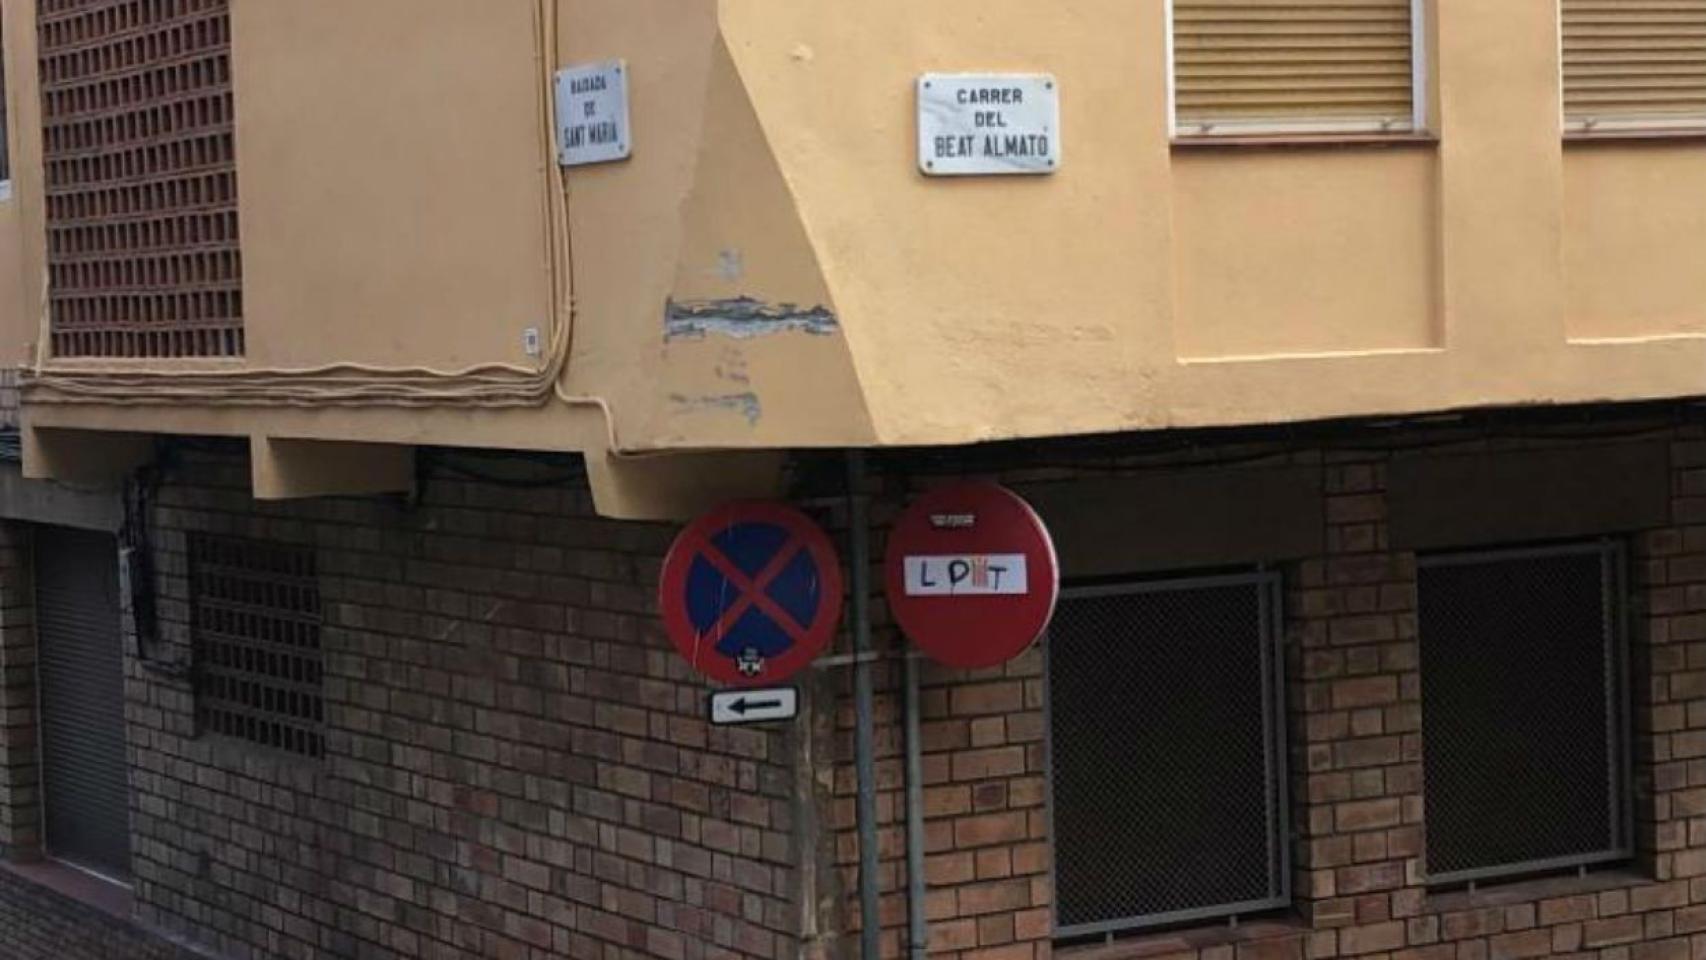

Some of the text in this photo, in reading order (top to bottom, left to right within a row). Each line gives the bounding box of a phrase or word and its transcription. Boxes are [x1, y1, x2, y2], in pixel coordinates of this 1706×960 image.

[956, 88, 1023, 105] CARRER
[584, 101, 596, 117] DE
[975, 111, 1008, 127] DEL
[564, 125, 585, 149] SANT
[934, 134, 975, 158] BEAT
